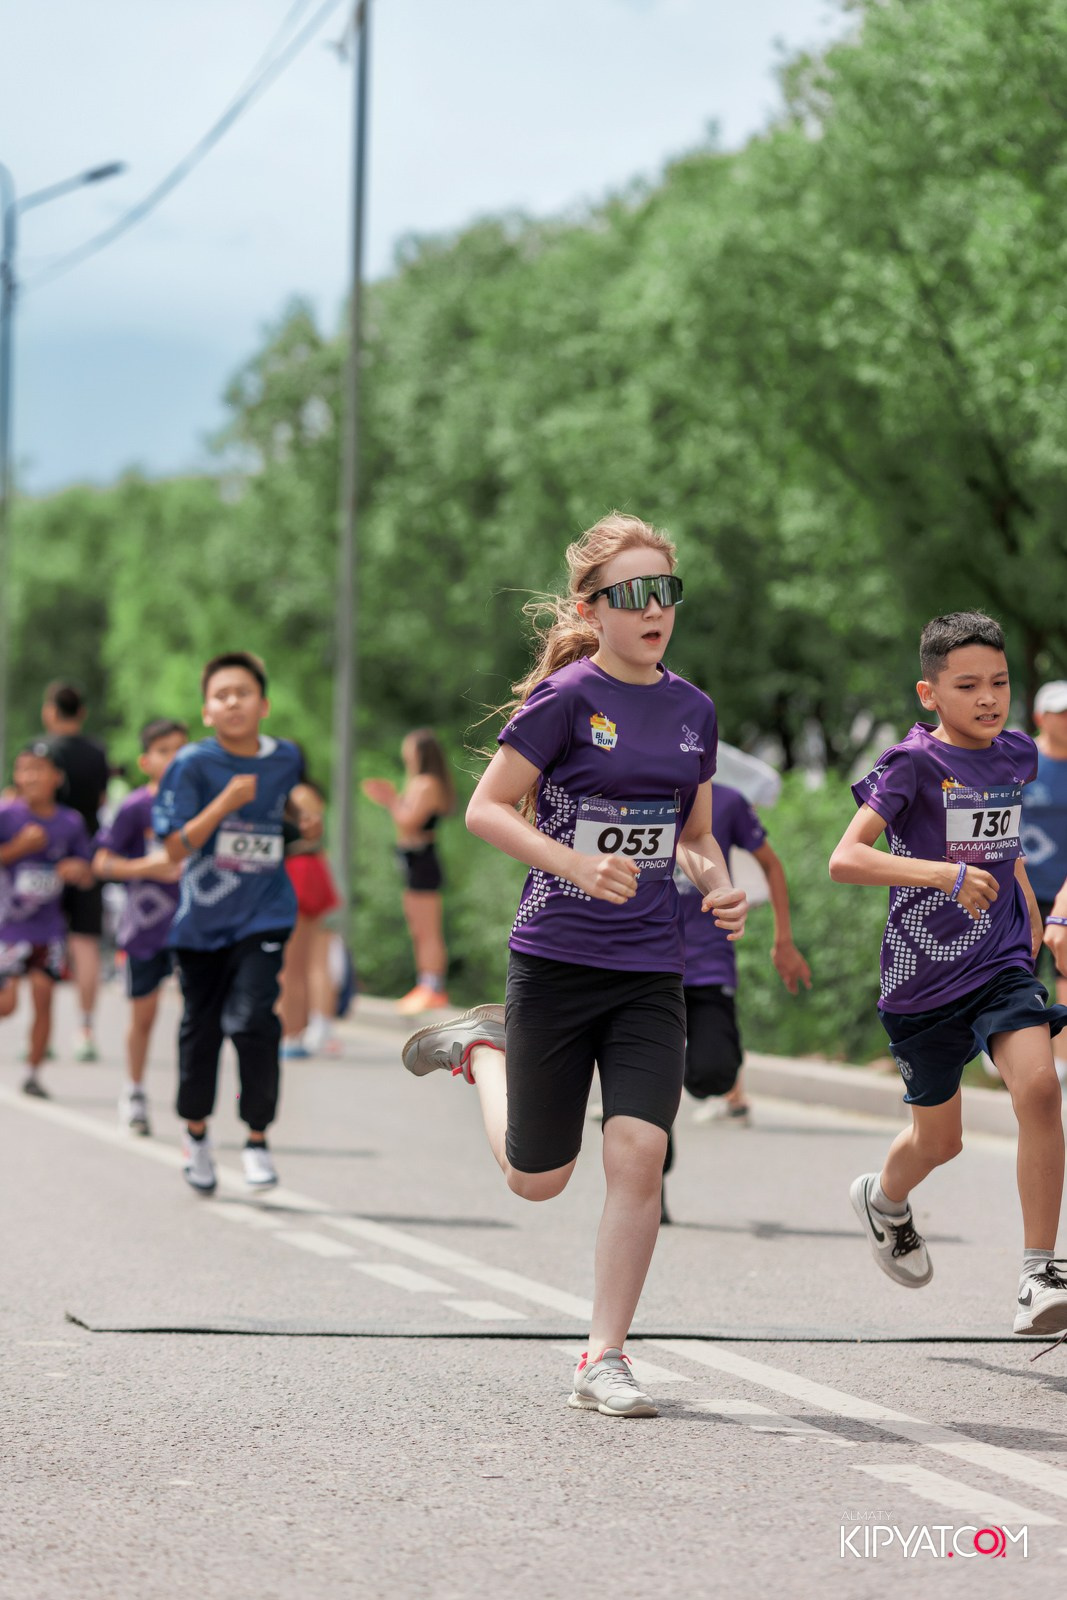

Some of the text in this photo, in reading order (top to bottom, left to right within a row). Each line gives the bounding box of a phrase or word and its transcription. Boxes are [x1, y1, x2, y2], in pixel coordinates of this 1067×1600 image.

[972, 810, 1011, 838] 130
[597, 827, 664, 856] 053
[950, 842, 996, 851] БАЛАЛАР
[985, 851, 999, 860] 600
